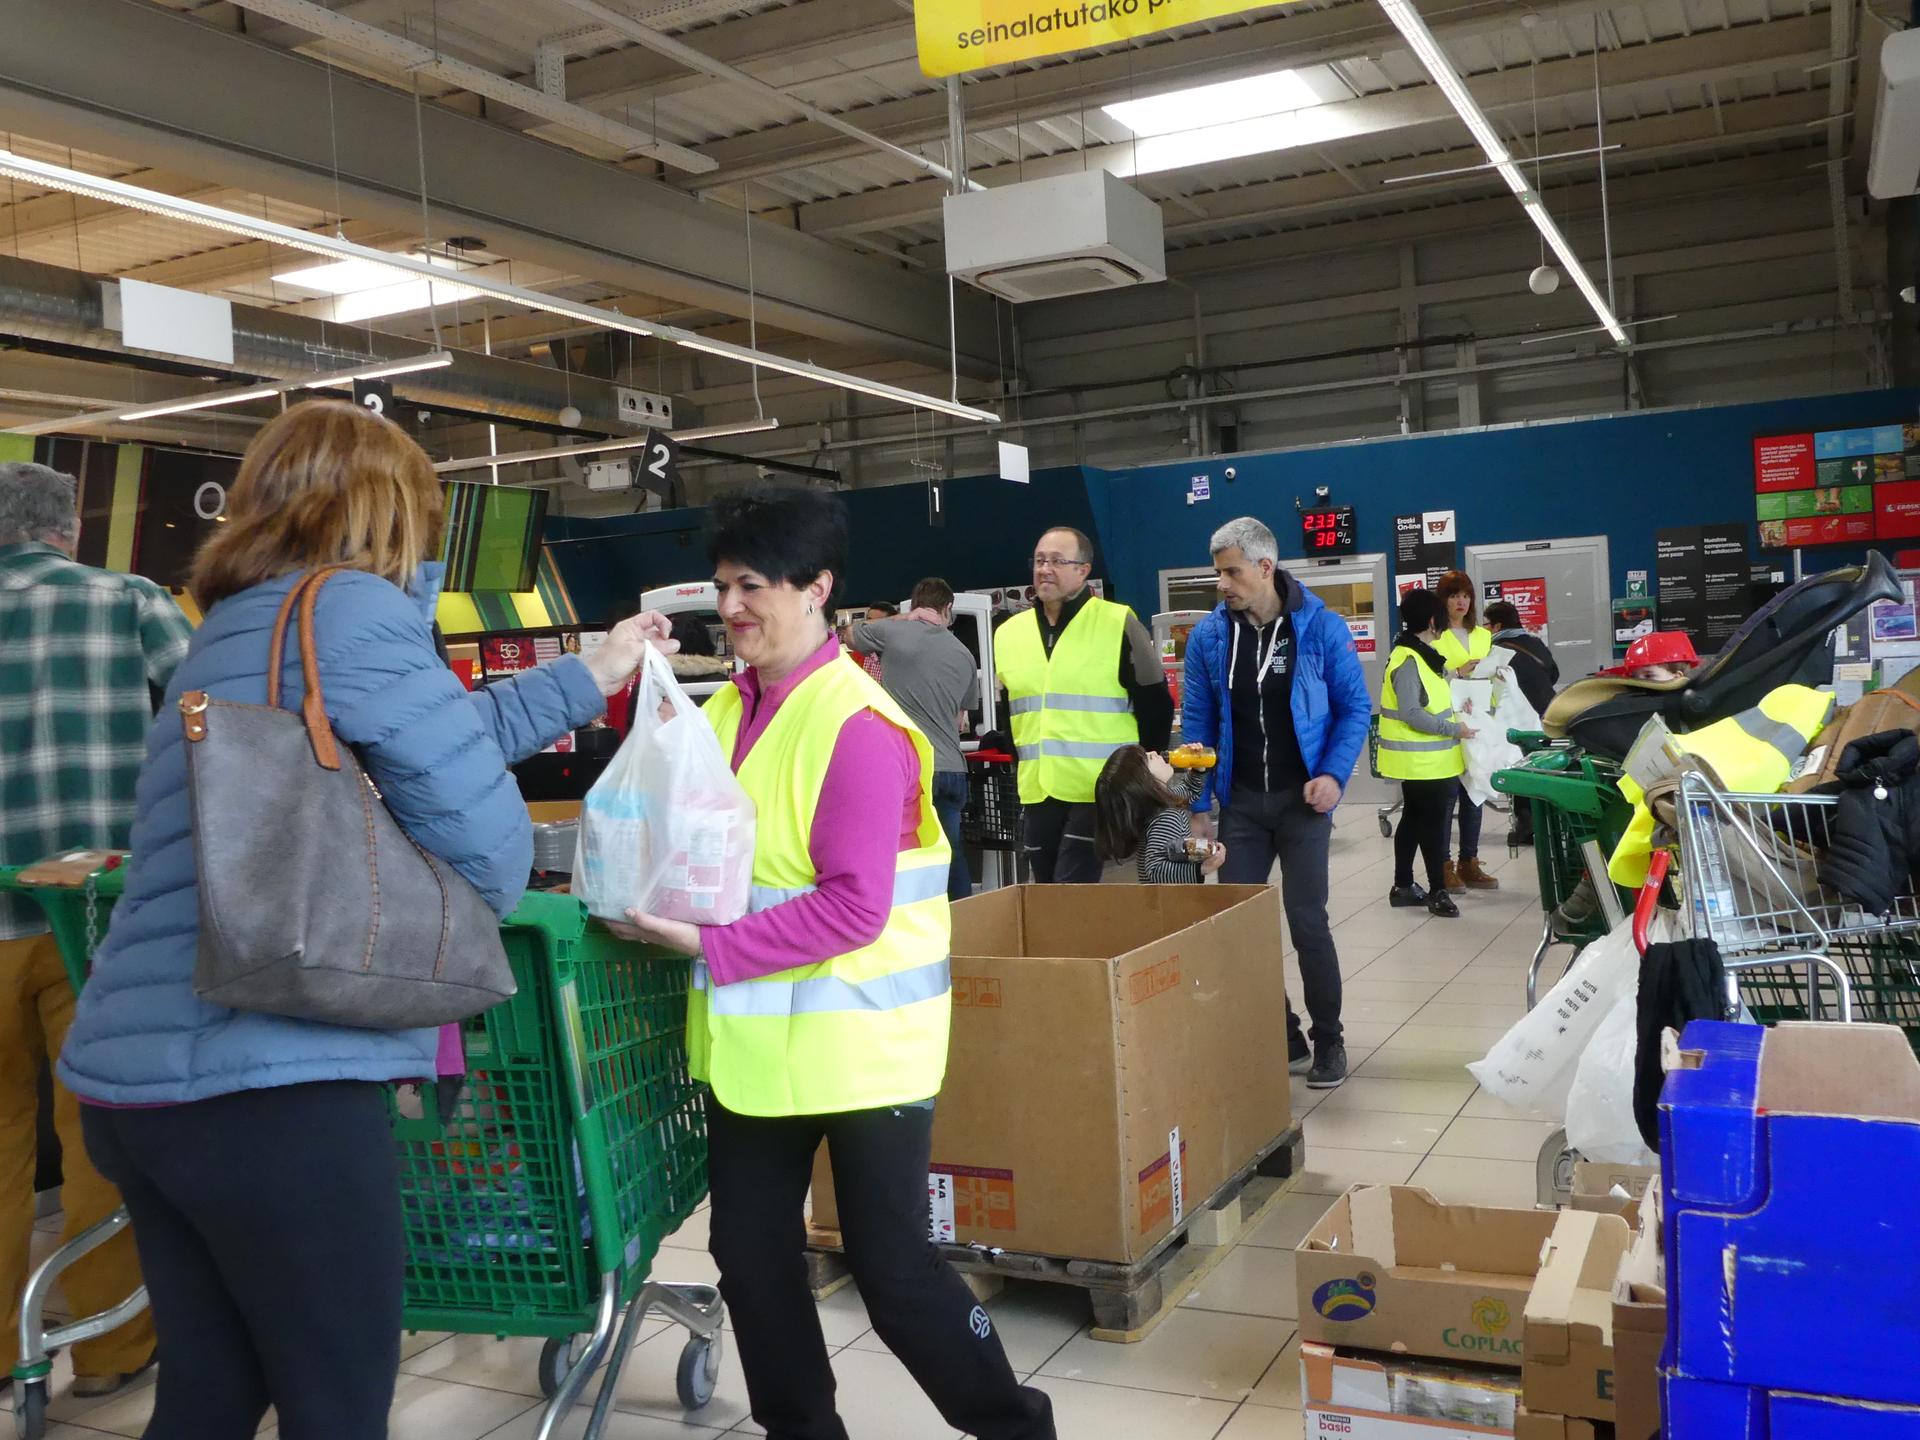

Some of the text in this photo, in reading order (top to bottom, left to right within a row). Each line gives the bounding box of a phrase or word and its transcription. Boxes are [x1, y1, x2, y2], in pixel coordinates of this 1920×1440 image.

[958, 0, 1138, 49] seinalatutako
[648, 443, 670, 479] 2
[933, 486, 940, 512] 1
[1315, 531, 1336, 547] 38
[500, 643, 520, 659] 50
[1319, 1417, 1352, 1434] basic
